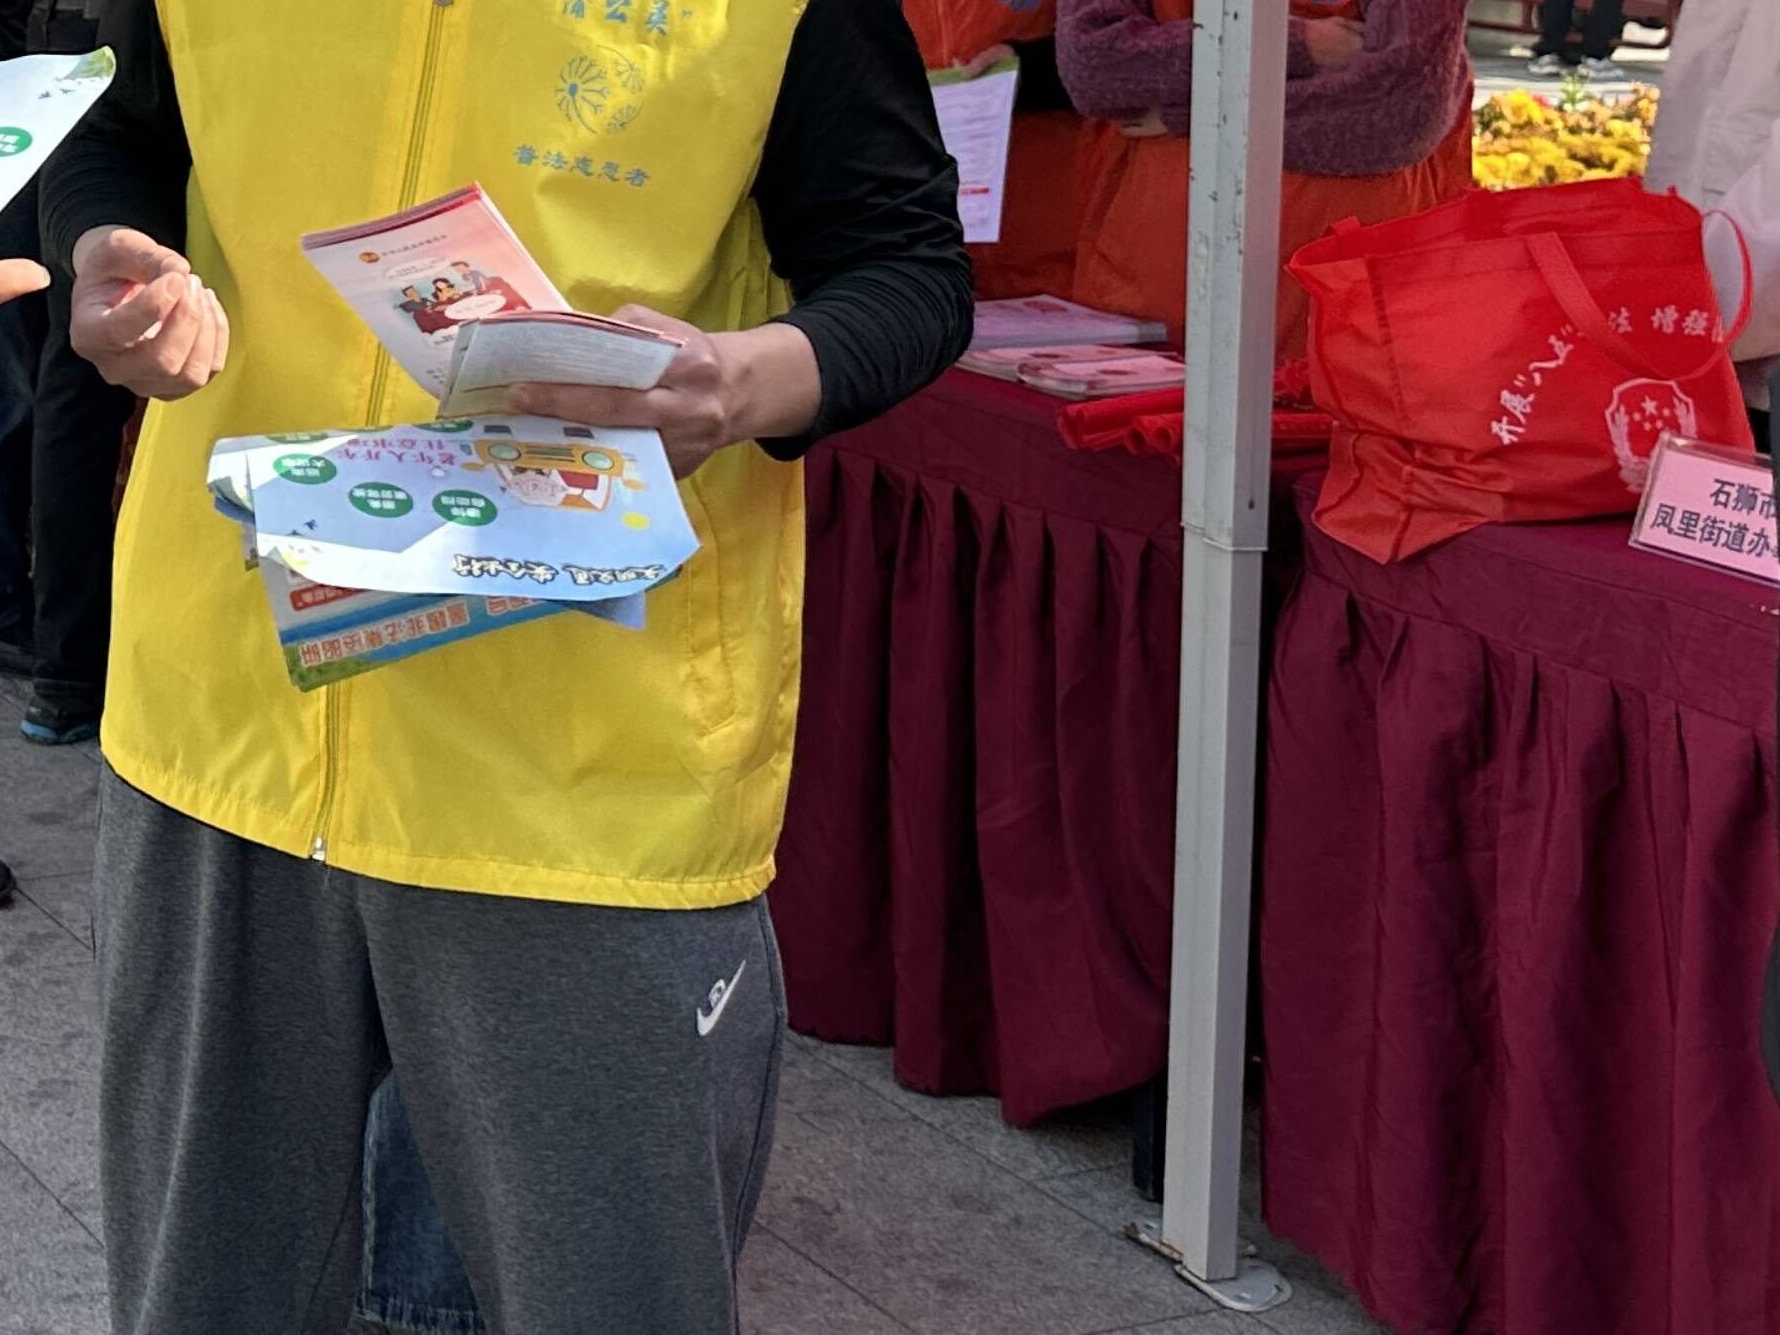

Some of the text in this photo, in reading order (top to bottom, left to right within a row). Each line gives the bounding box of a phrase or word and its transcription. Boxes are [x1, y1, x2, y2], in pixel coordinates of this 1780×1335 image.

[515, 144, 650, 187] 普法志愿者
[1651, 304, 1724, 343] 增强
